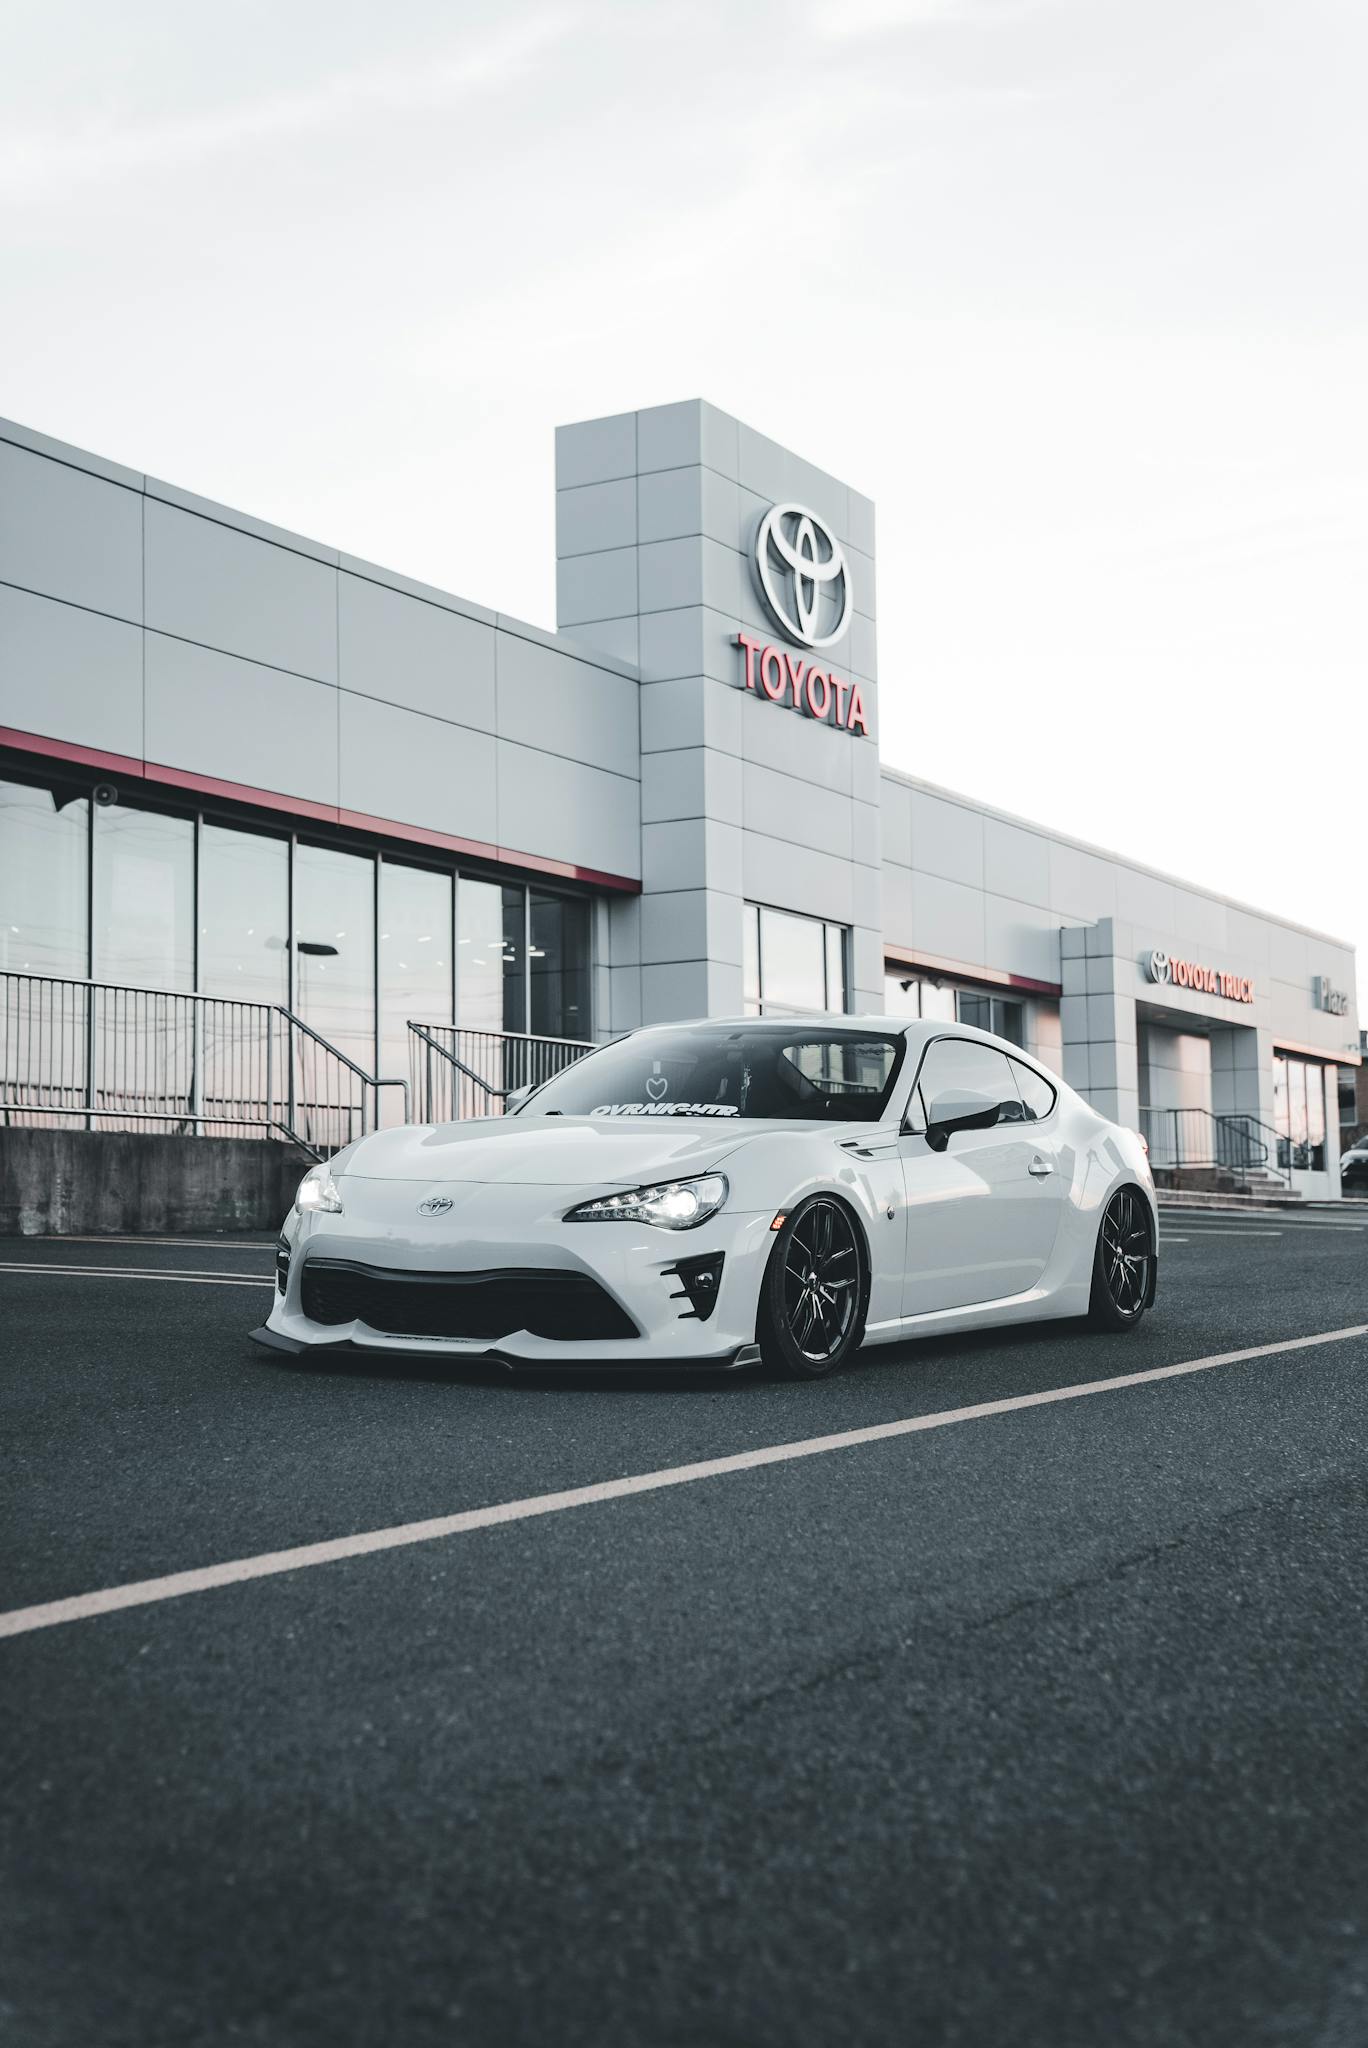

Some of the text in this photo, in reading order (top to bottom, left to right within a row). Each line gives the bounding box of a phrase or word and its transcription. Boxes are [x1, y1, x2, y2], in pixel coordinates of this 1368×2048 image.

[737, 633, 869, 736] TOYOTA
[1169, 957, 1255, 1003] TOYOTA TRUCK
